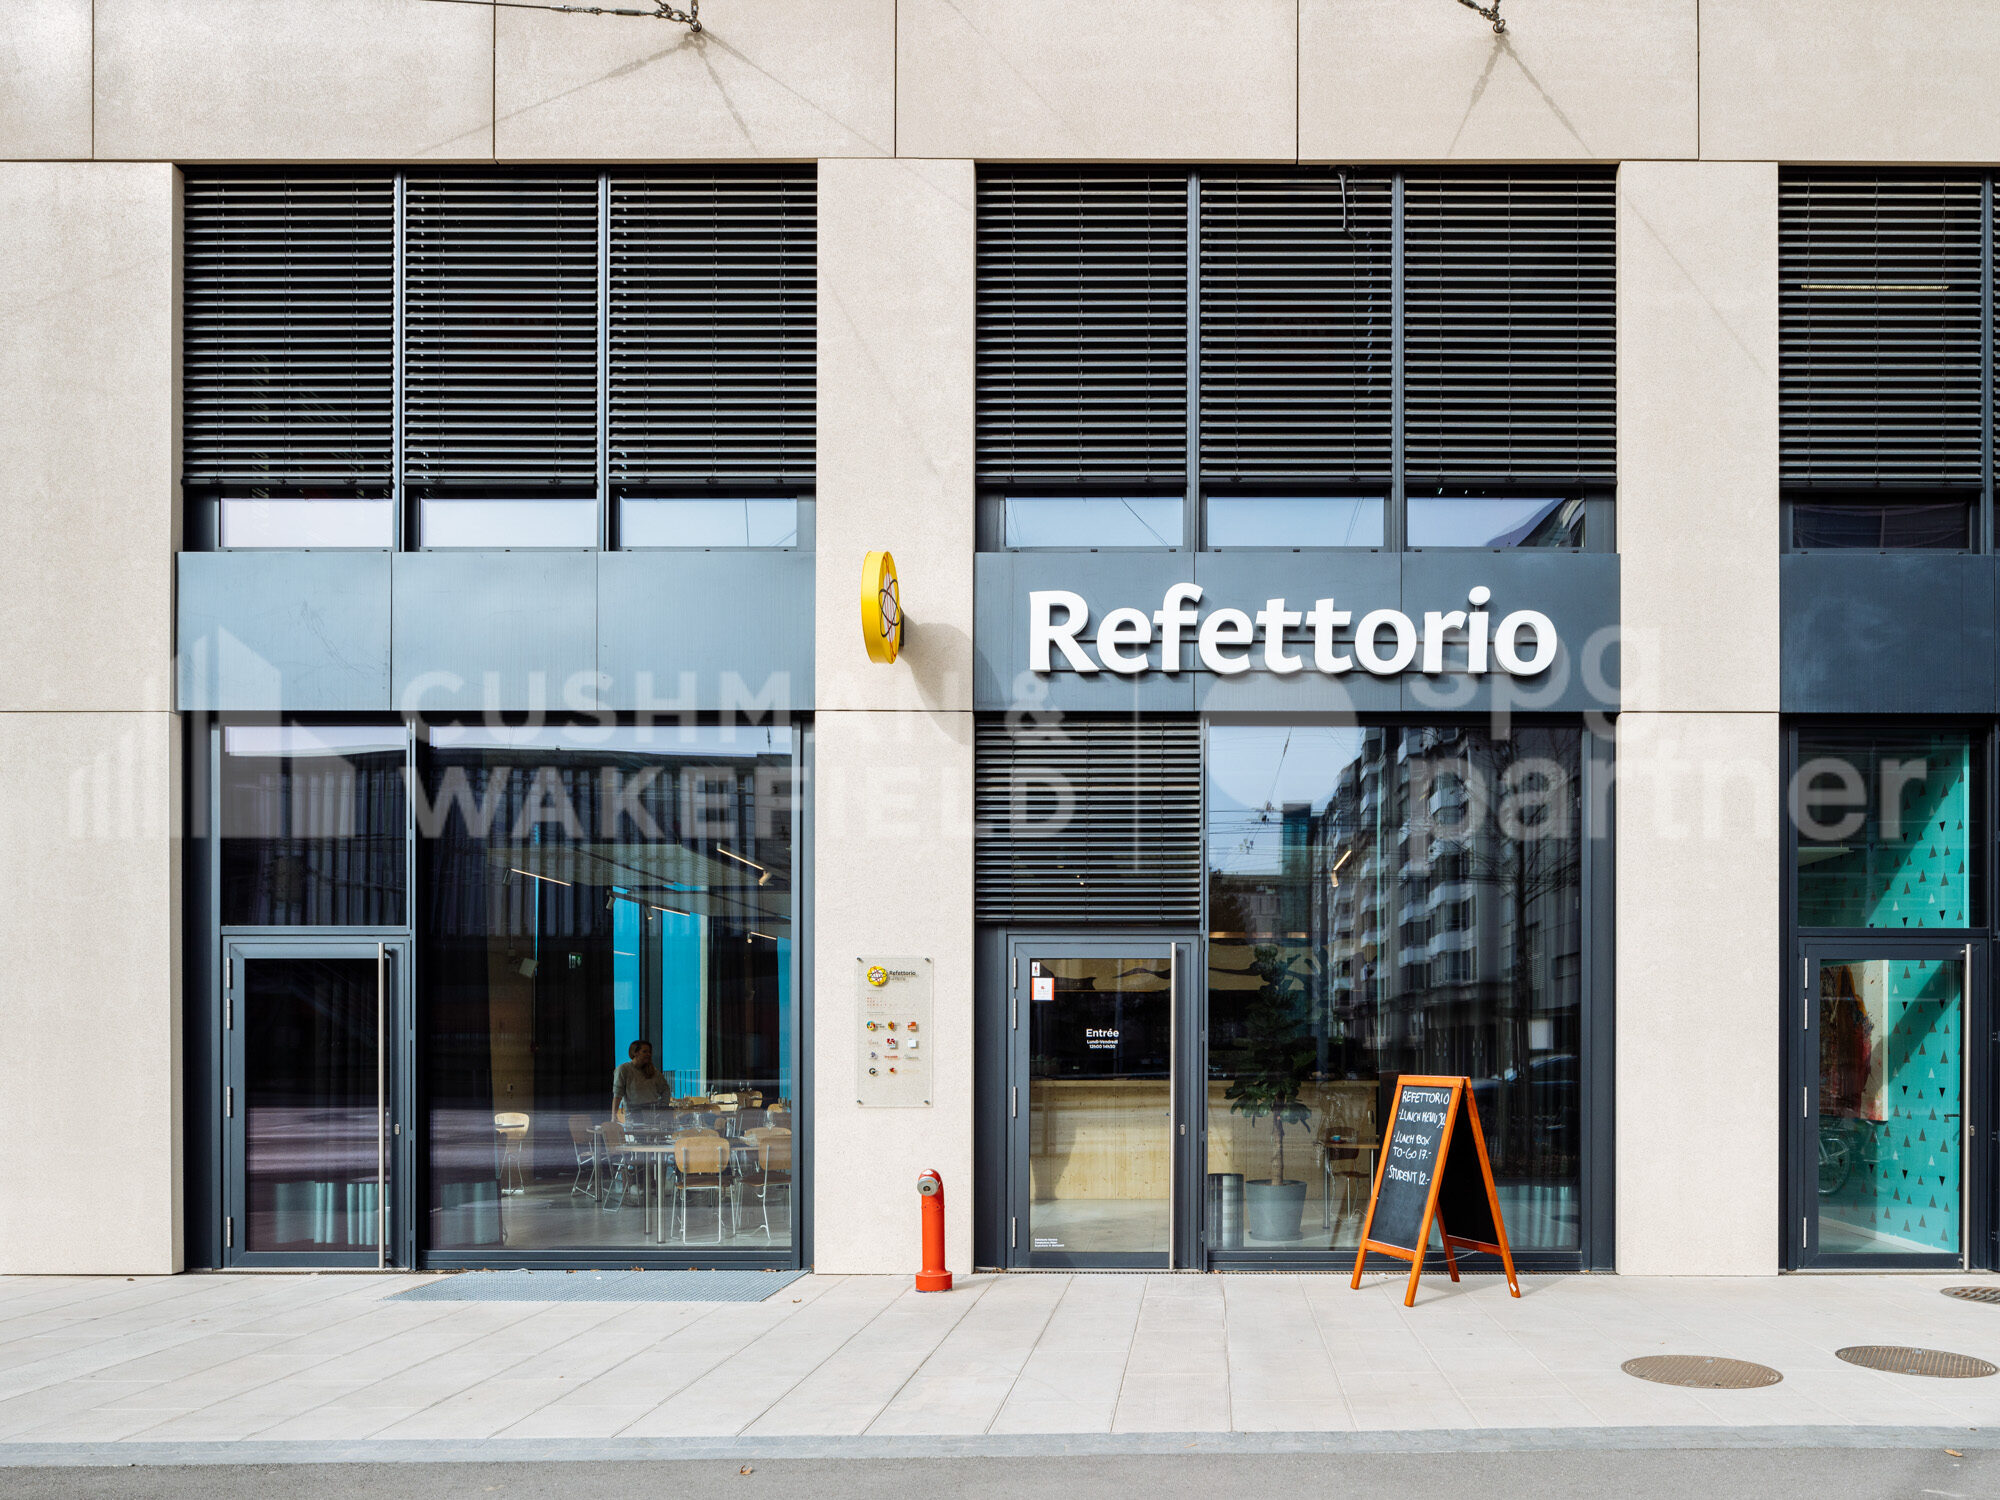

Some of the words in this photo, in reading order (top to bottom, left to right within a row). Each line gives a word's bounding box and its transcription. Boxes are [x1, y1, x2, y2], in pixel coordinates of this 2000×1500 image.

[1029, 582, 1558, 677] Refettorio
[1086, 1028, 1120, 1038] Entrée
[1401, 1091, 1450, 1105] REFETTORIO
[1421, 1111, 1438, 1124] MENU
[1416, 1134, 1432, 1146] BOX
[1393, 1146, 1417, 1159] TO-GO
